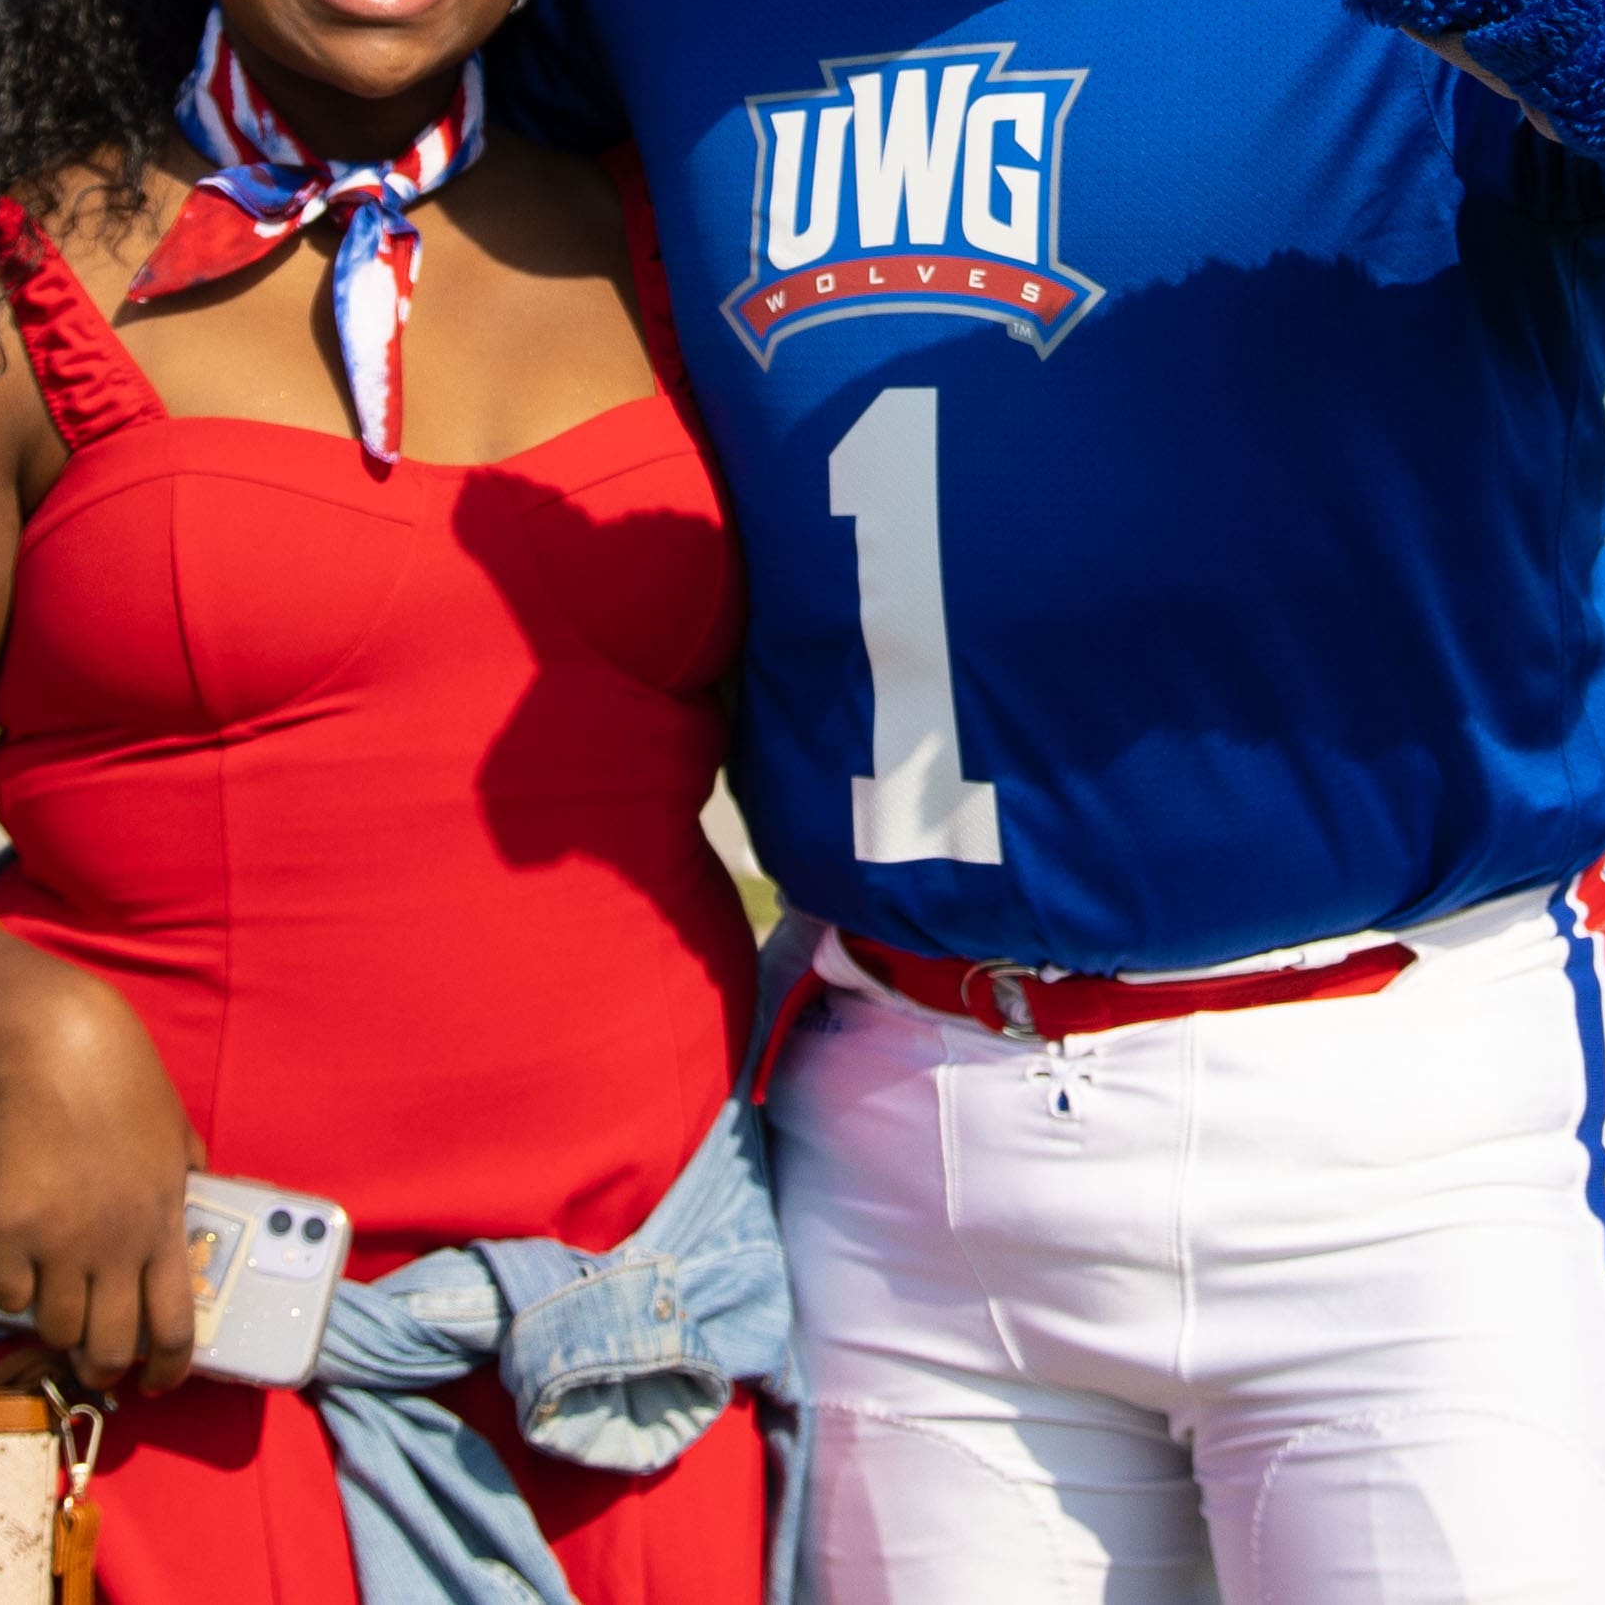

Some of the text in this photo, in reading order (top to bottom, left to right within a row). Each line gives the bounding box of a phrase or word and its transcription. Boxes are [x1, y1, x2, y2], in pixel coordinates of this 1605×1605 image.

[768, 64, 1045, 271] UWG
[765, 264, 1043, 313] WOLVES
[1013, 322, 1032, 339] TM
[828, 388, 1004, 865] 1
